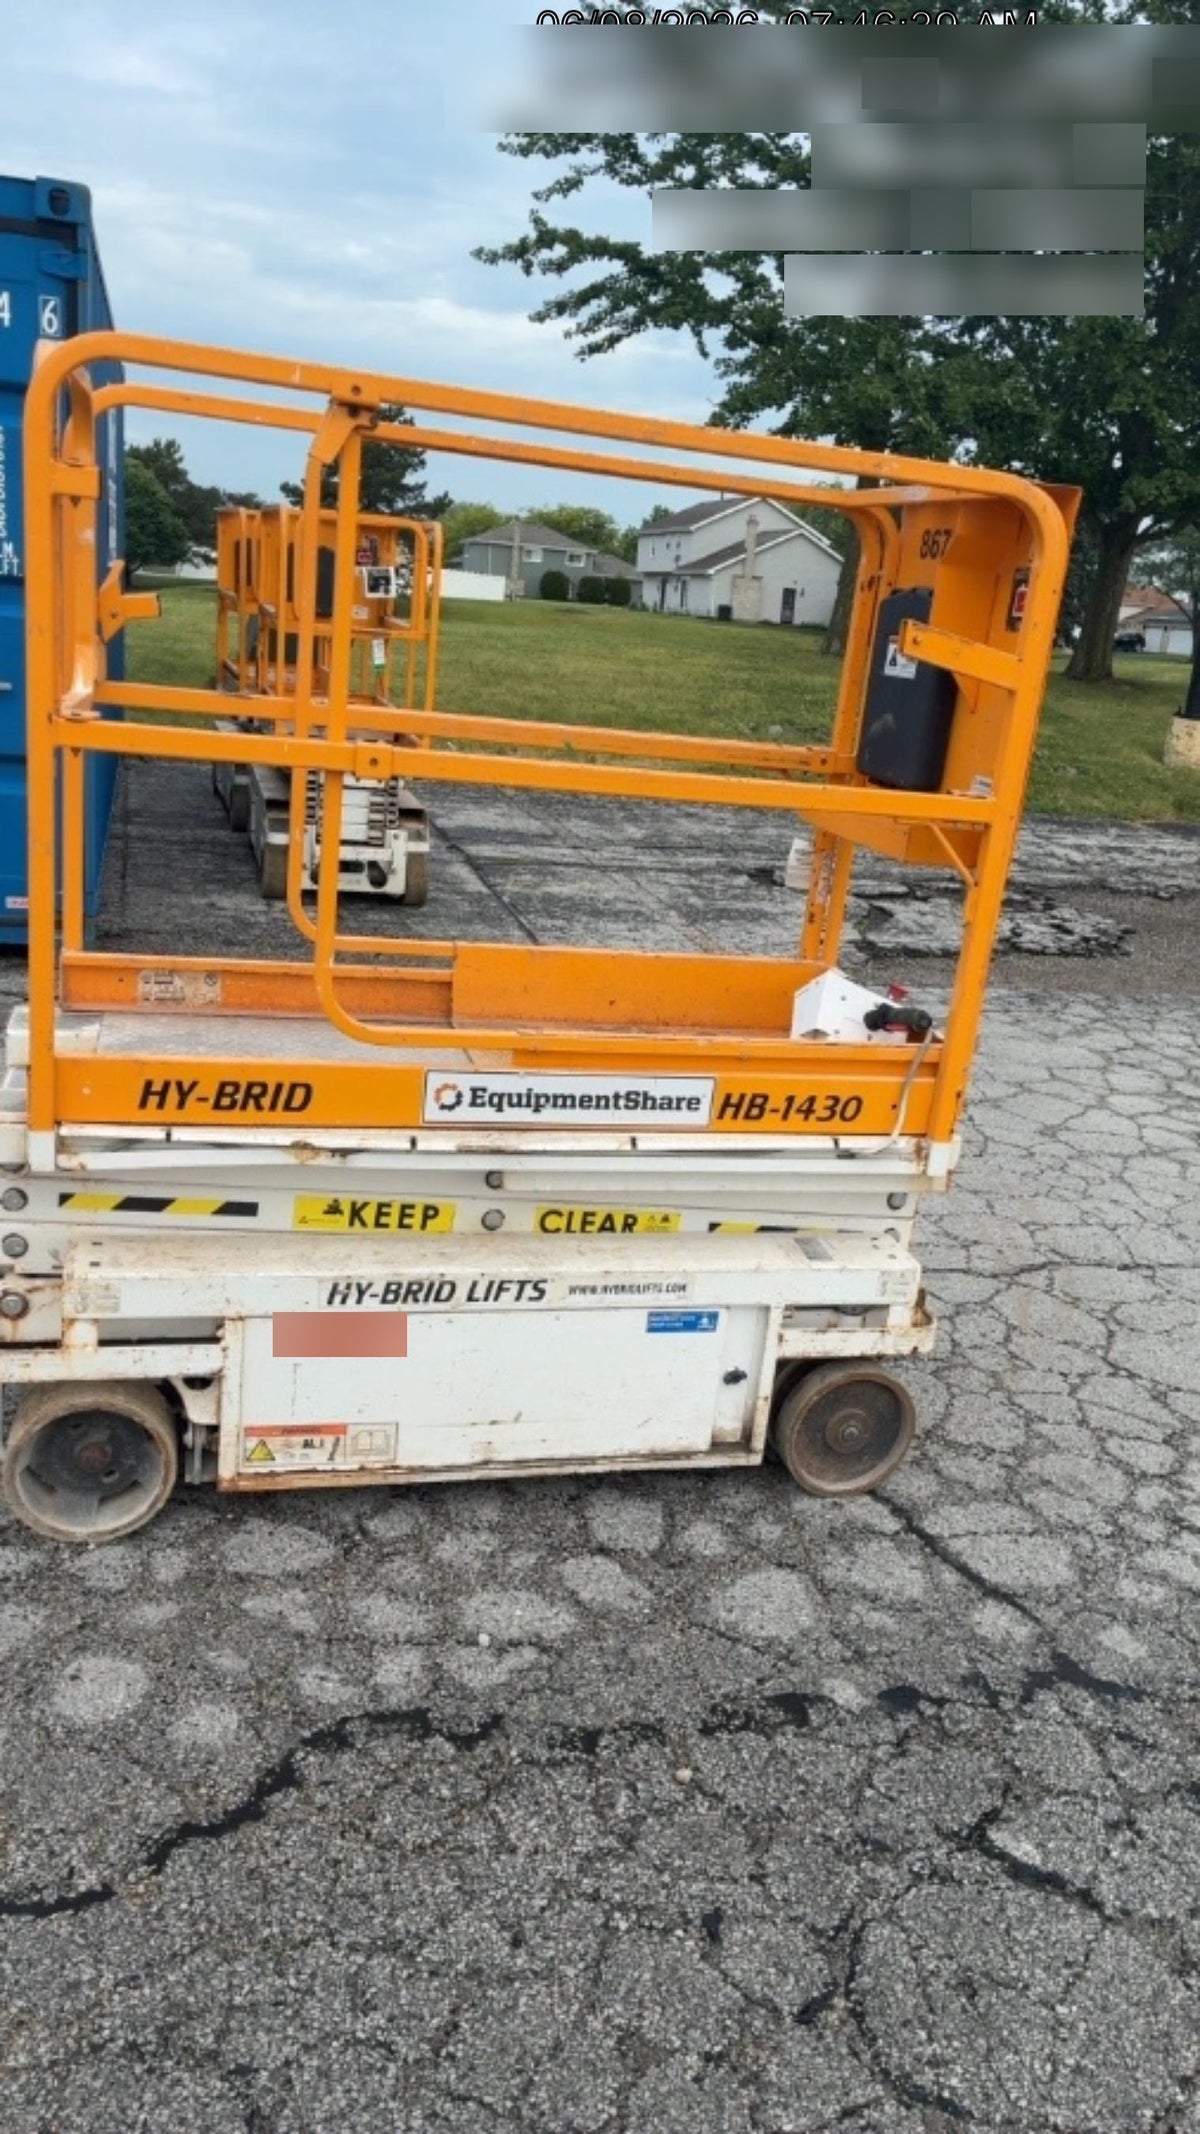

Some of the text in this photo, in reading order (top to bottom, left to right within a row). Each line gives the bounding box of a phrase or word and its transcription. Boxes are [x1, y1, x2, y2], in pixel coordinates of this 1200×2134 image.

[42, 300, 58, 334] 6
[920, 528, 952, 560] 867
[138, 1079, 313, 1113] HY-BRID
[469, 1086, 701, 1113] EquipmentShare
[717, 1093, 863, 1122] HB-1430
[348, 1201, 440, 1231] KEEP
[539, 1209, 639, 1234] CLEAR
[326, 1279, 548, 1305] HY-BRID LIFTS
